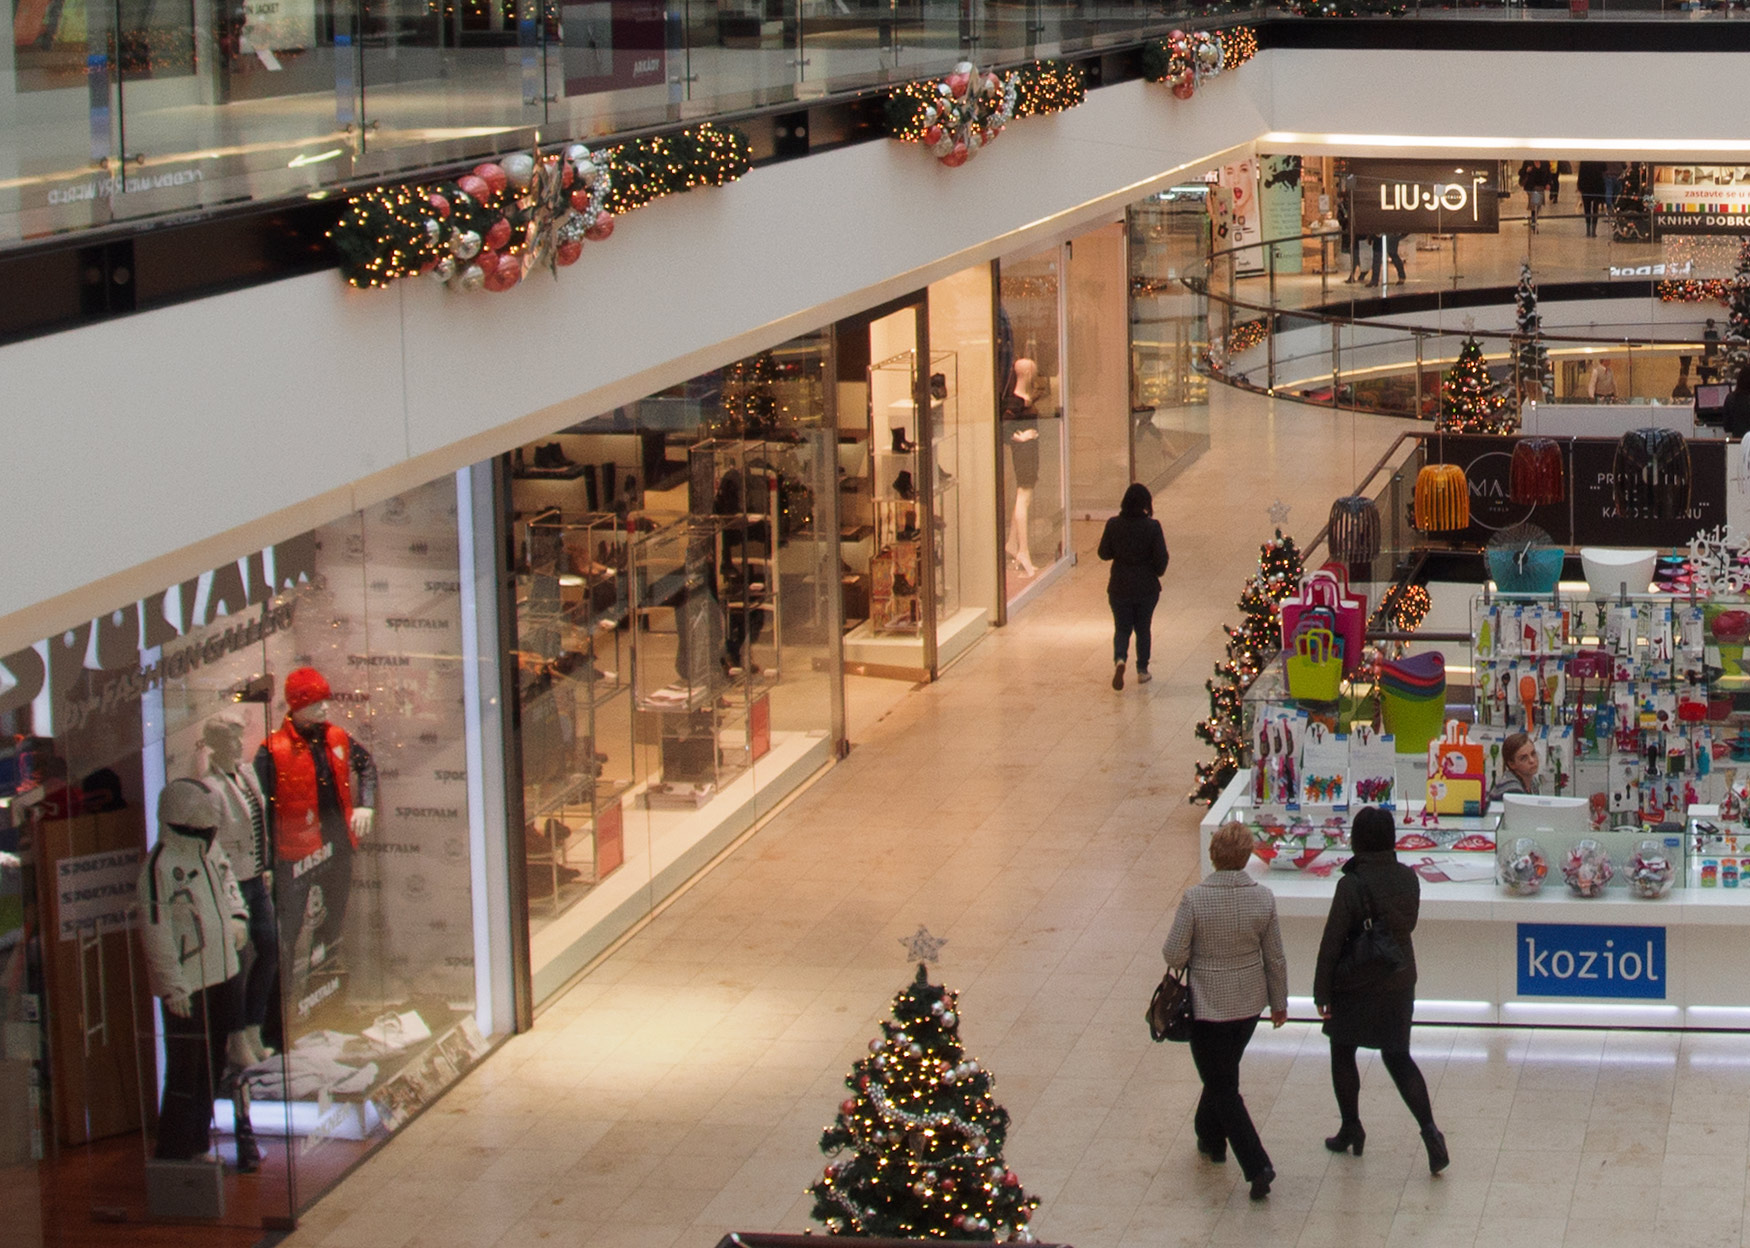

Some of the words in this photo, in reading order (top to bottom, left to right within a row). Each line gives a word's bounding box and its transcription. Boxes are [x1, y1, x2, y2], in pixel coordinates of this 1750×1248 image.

[1684, 190, 1724, 198] zastavte
[1657, 215, 1702, 226] KNIHY
[1525, 936, 1659, 981] koziol
